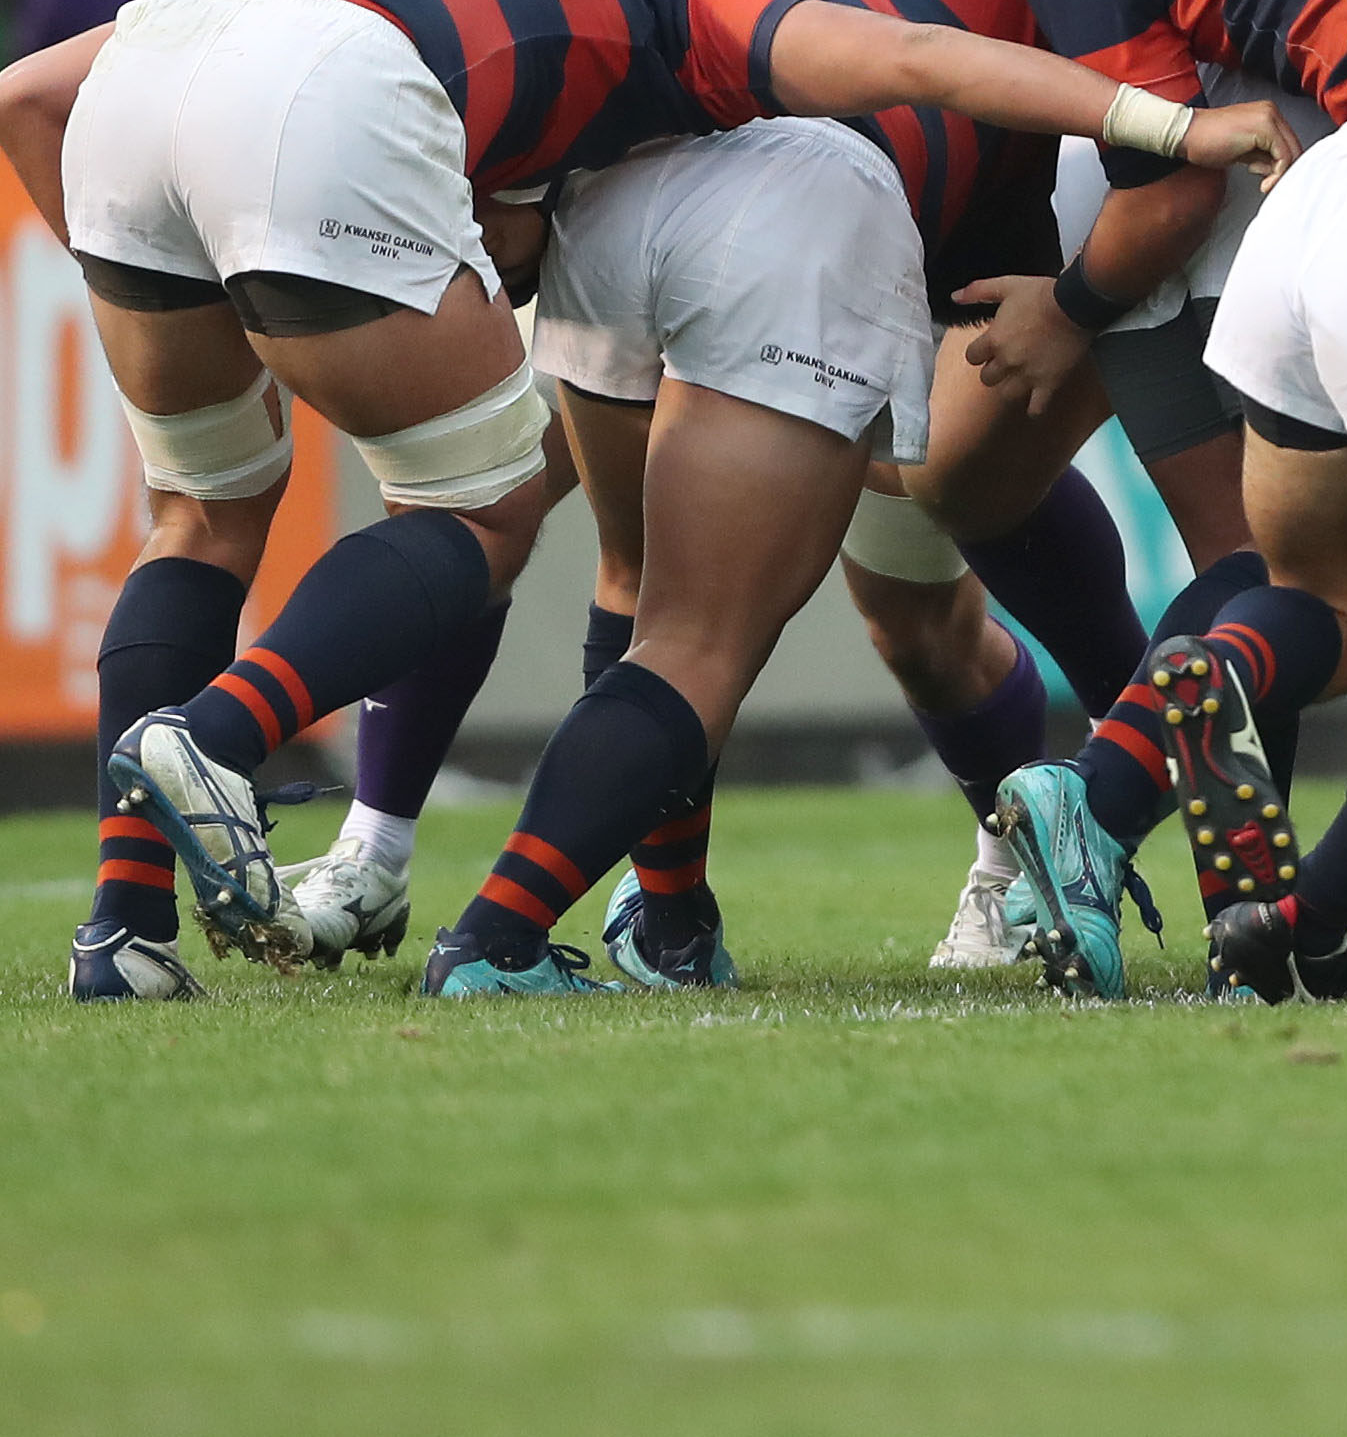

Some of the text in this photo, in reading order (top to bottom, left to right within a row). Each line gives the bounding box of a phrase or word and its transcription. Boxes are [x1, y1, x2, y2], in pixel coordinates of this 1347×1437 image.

[344, 223, 434, 257] KWANSEI GAKUIN
[371, 243, 400, 260] UNIV.
